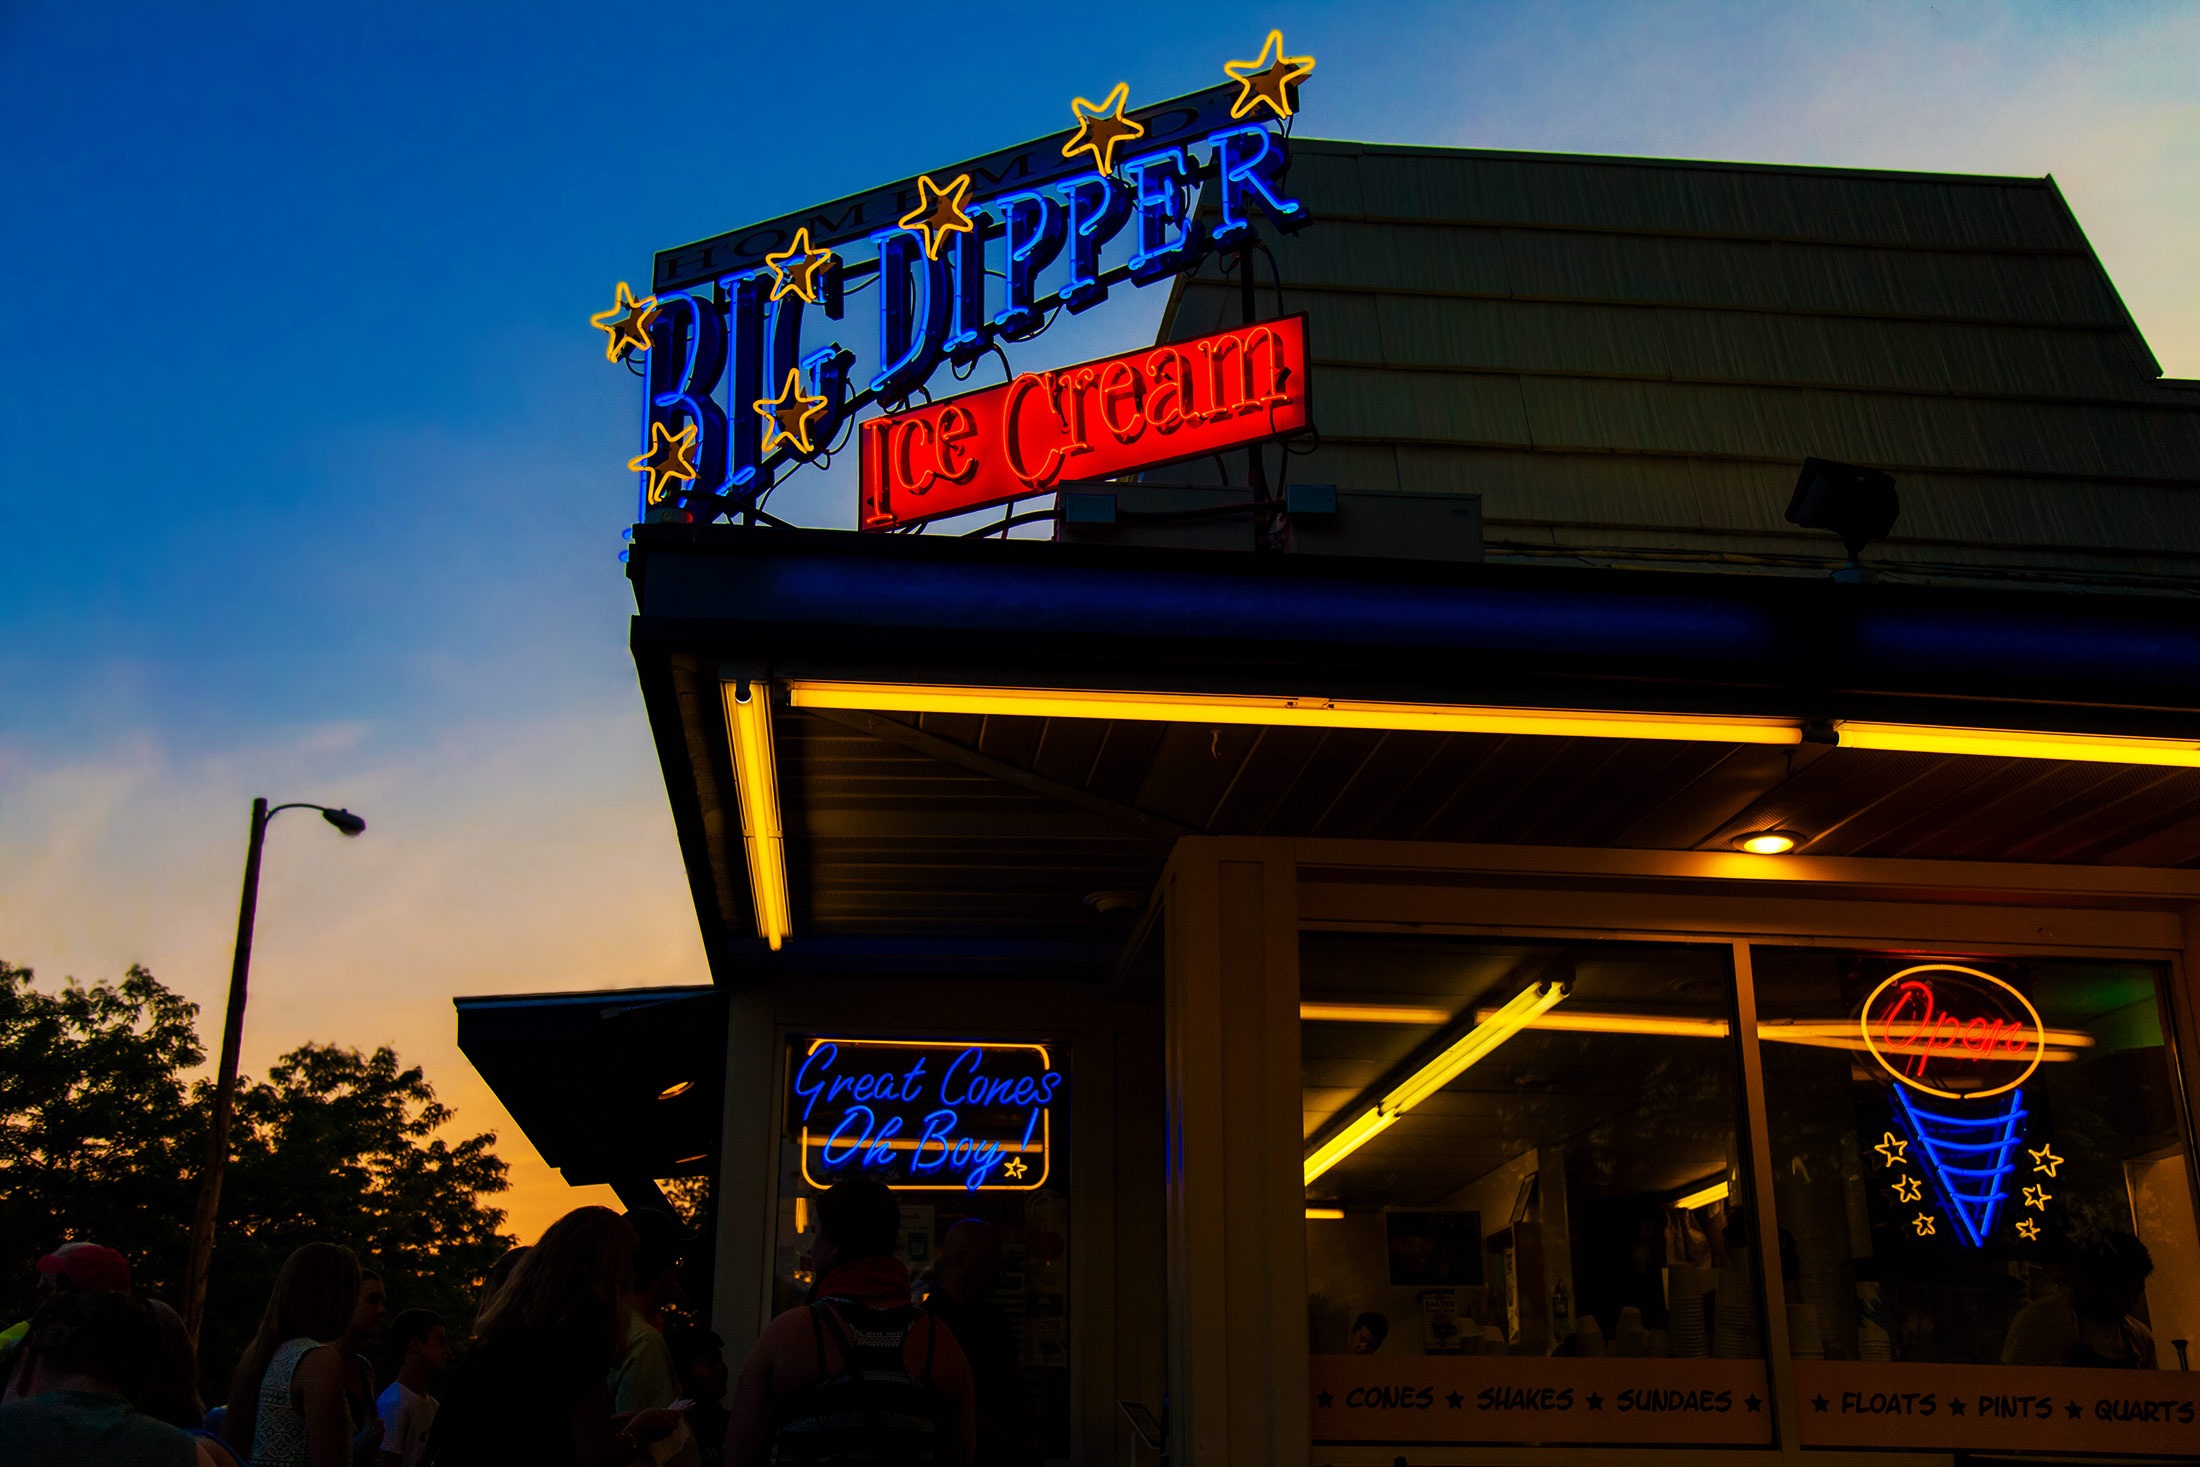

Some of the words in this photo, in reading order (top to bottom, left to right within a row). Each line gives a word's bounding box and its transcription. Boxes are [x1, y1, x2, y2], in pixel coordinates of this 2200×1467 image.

[659, 84, 1258, 282] HOMEMD
[639, 252, 856, 526] BIG
[869, 123, 1313, 409] DIPPER
[862, 400, 981, 528] Ice
[1000, 326, 1292, 488] Cream
[1881, 980, 2028, 1078] Open
[794, 1042, 928, 1120] Great
[939, 1046, 1062, 1107] Cones
[822, 1104, 906, 1167] Oh
[1346, 1387, 1434, 1409] CONES
[1477, 1387, 1574, 1411] SHAKES
[1617, 1389, 1733, 1413] SUNDAES
[1842, 1392, 1936, 1416] FLOATS
[1979, 1395, 2053, 1418] PINTS
[2095, 1399, 2196, 1424] QUARTS
